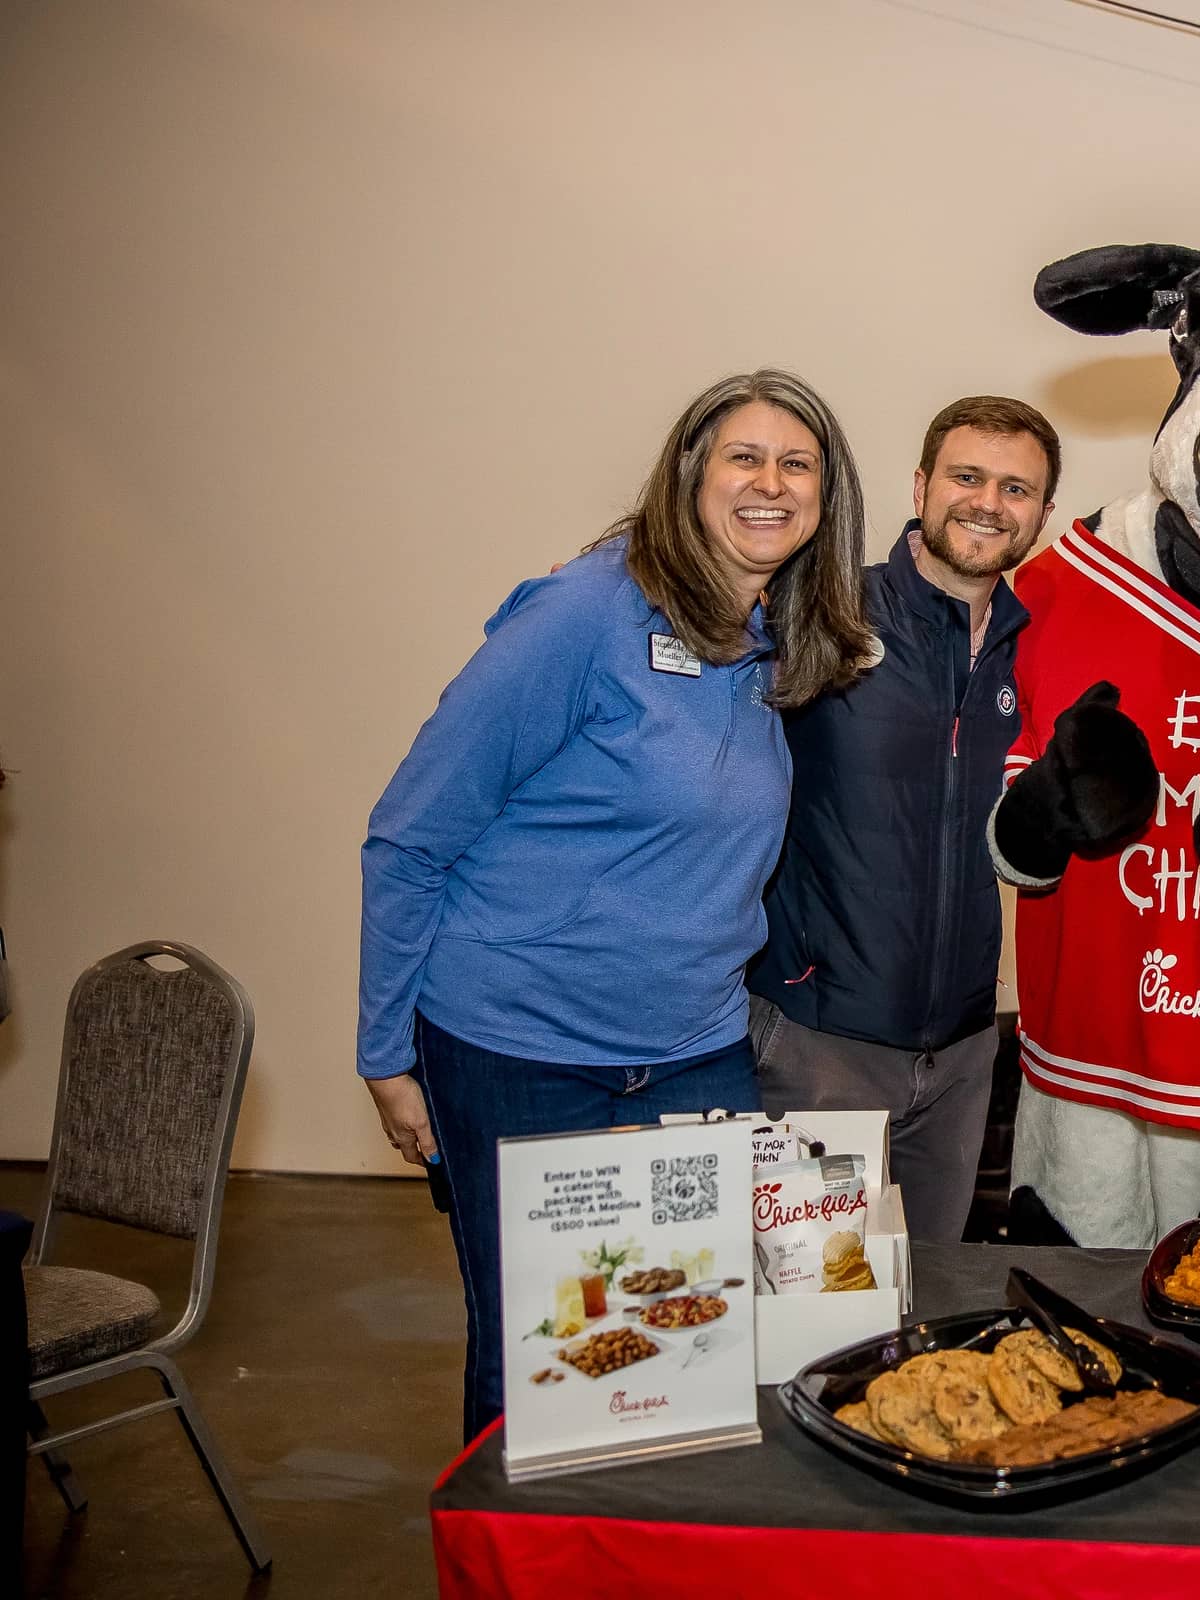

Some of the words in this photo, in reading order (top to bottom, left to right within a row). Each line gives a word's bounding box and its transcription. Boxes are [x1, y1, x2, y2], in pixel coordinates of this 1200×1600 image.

[764, 1139, 785, 1151] MOR
[544, 1171, 576, 1182] Enter
[580, 1168, 593, 1178] to
[596, 1165, 621, 1177] WIN
[563, 1180, 612, 1193] catering
[544, 1195, 593, 1210] package
[597, 1190, 622, 1201] with
[599, 1201, 641, 1212] Medina
